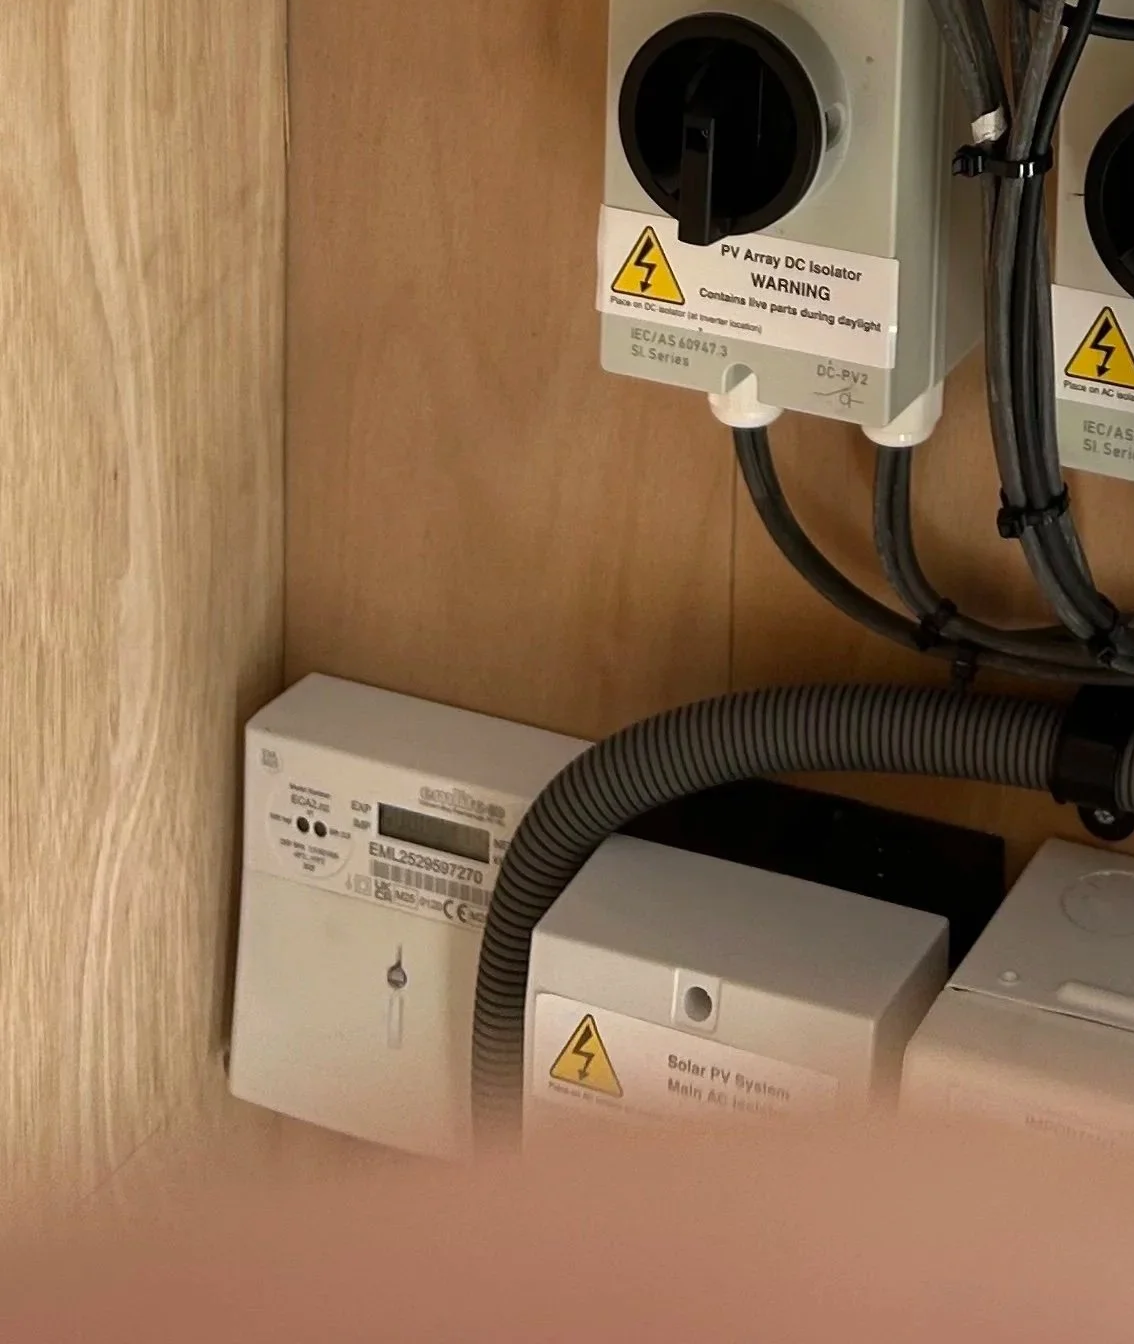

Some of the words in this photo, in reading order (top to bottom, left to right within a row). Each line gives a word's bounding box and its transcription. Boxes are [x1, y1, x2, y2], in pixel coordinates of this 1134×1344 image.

[721, 244, 741, 259] PV
[743, 248, 782, 270] Array
[785, 256, 806, 272] DC
[809, 261, 863, 282] Isolator
[750, 272, 832, 301] WARNING
[699, 287, 747, 307] Contains
[749, 296, 768, 311] live
[769, 301, 798, 316] parts
[799, 307, 836, 326] during
[838, 315, 882, 334] daylight
[631, 326, 677, 347] IEC/AS
[650, 347, 690, 367] Series
[816, 364, 869, 386] DC-PV2
[1063, 379, 1087, 393] Place
[1088, 385, 1100, 394] on
[1100, 387, 1115, 398] AC
[1083, 419, 1134, 443] IEC/AS
[667, 1054, 706, 1079] Solar
[710, 1065, 731, 1085] PV
[735, 1073, 791, 1103] System
